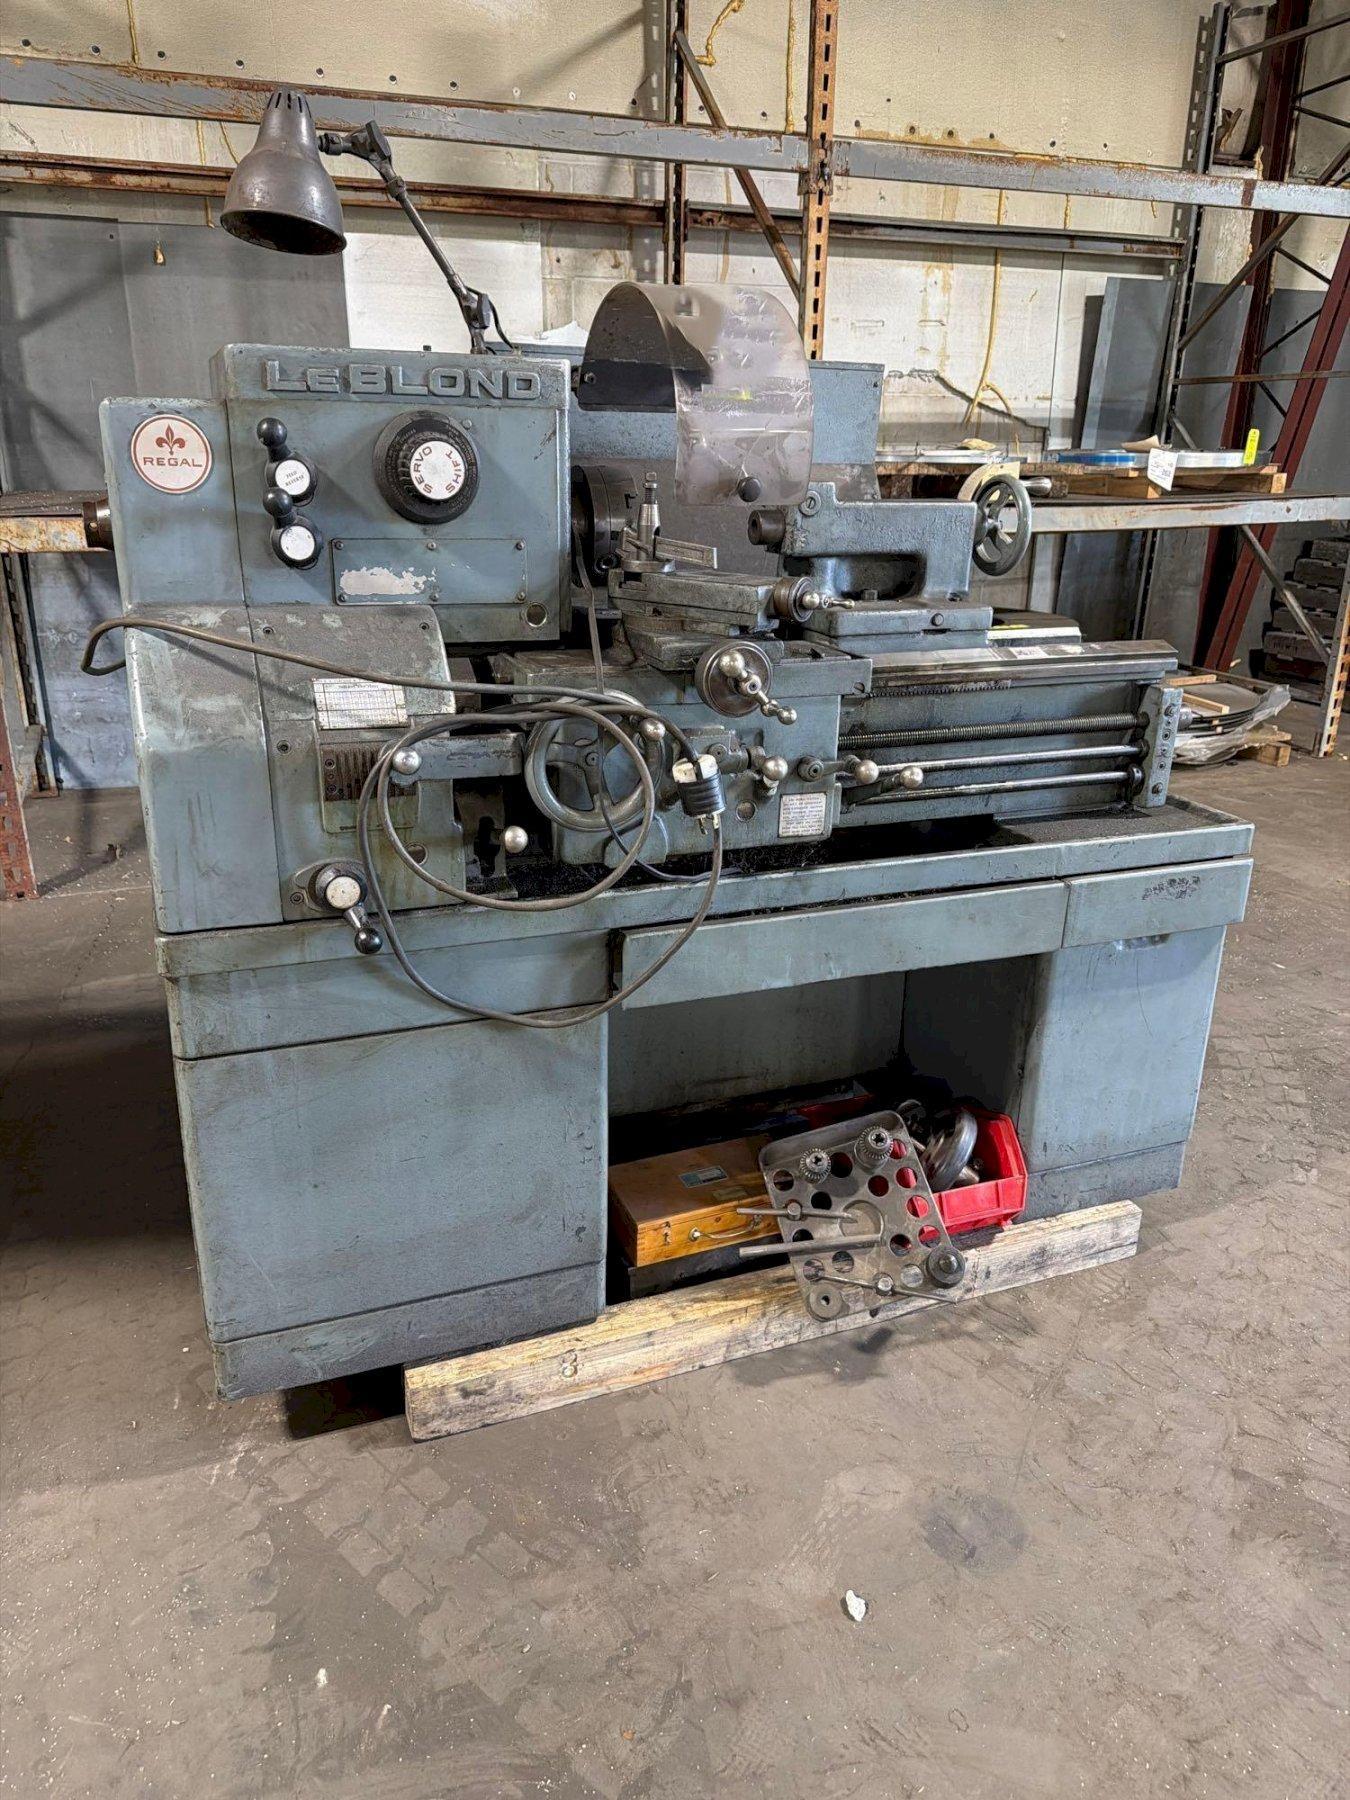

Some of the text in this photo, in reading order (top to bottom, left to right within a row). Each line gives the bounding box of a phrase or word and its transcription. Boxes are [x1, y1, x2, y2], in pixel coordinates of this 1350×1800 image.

[142, 456, 203, 468] REGAL
[413, 446, 433, 494] SERVO
[445, 450, 462, 494] SHIFT
